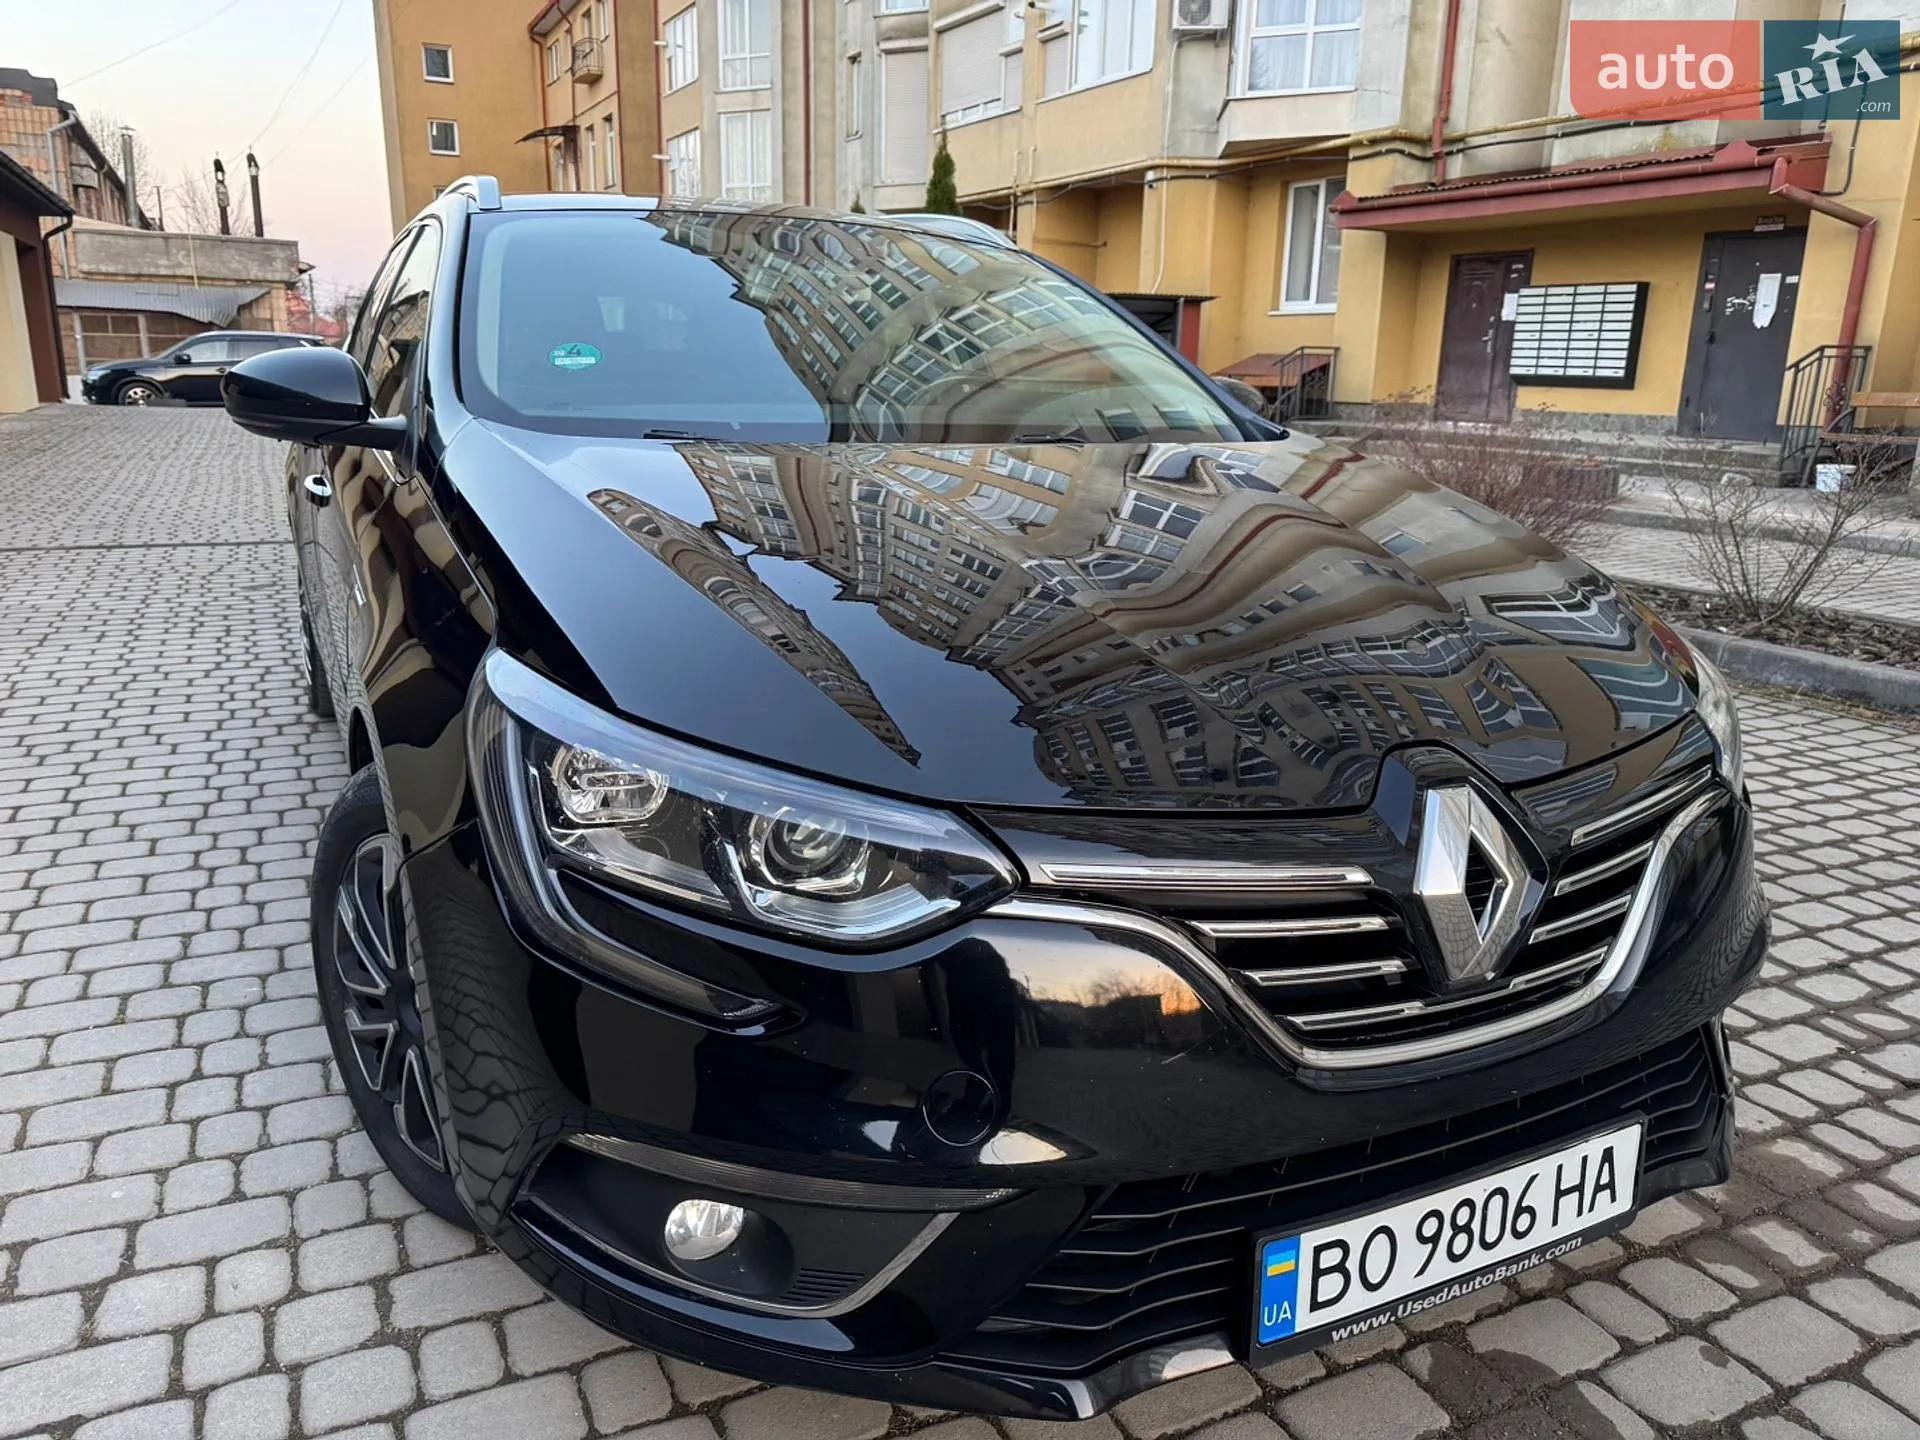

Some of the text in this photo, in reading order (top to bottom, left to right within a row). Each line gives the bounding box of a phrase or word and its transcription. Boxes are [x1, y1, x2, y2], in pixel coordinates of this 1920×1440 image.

[567, 343, 582, 356] 4
[1309, 1145, 1618, 1313] BO 9806 HA
[1263, 1301, 1292, 1326] UA
[1331, 1237, 1583, 1342] www.UsedAutoBank.com
